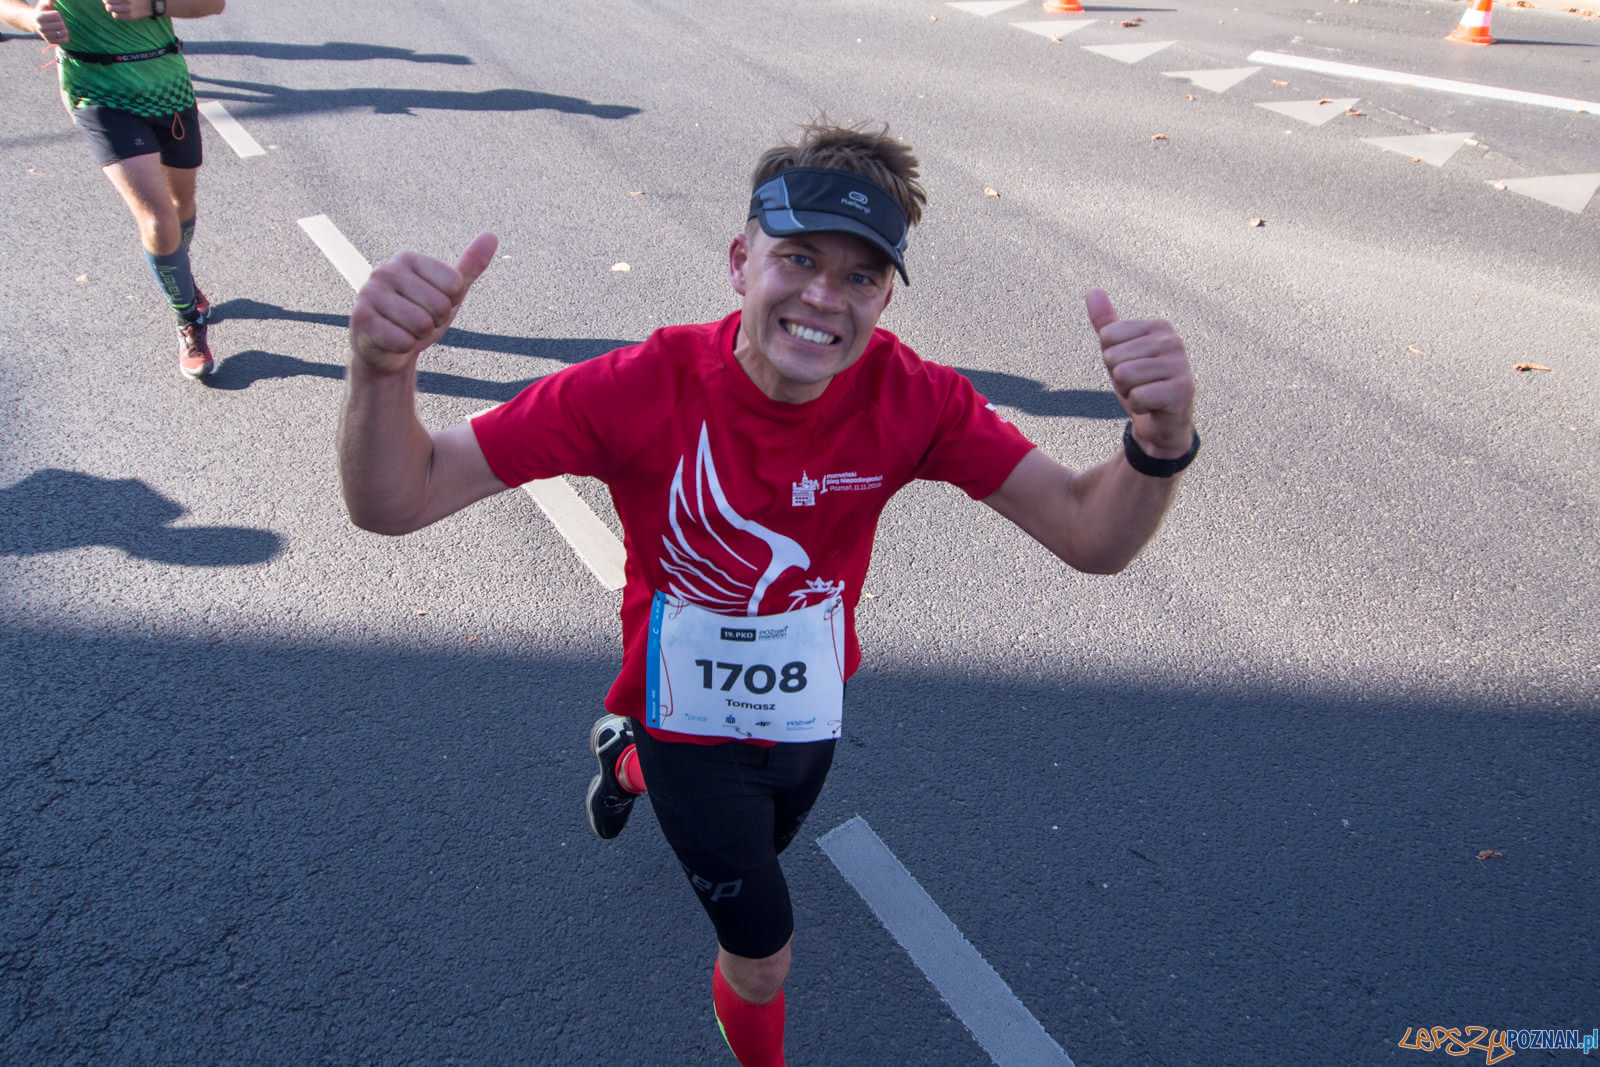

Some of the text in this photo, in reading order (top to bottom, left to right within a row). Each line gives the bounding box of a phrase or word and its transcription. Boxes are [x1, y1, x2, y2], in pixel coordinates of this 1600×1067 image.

[735, 631, 753, 640] PKO
[695, 659, 808, 694] 1708
[725, 698, 776, 711] Tomasz
